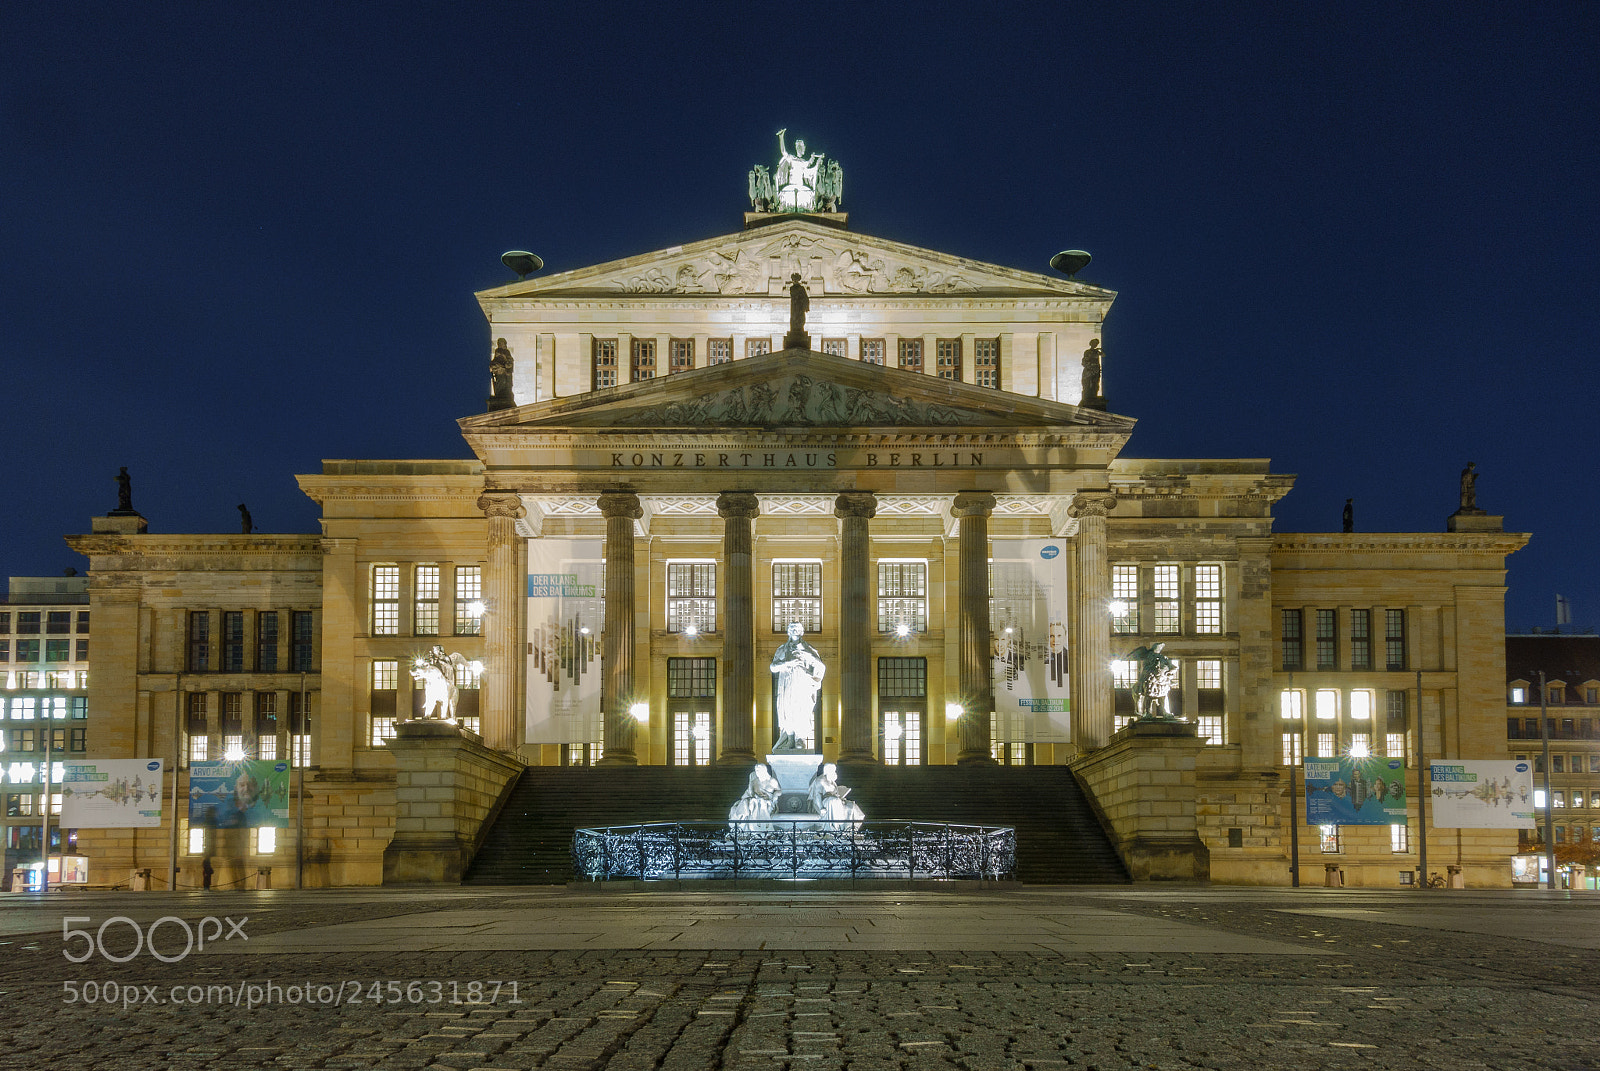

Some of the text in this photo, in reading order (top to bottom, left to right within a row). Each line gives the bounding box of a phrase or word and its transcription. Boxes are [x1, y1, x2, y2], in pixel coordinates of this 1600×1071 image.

[611, 453, 984, 467] KONZERTHAUS BERLIN
[533, 575, 576, 586] DER KLANG
[533, 586, 594, 597] DES BALTIKUMS
[193, 767, 211, 776] ARVO
[1306, 763, 1320, 771] LATE
